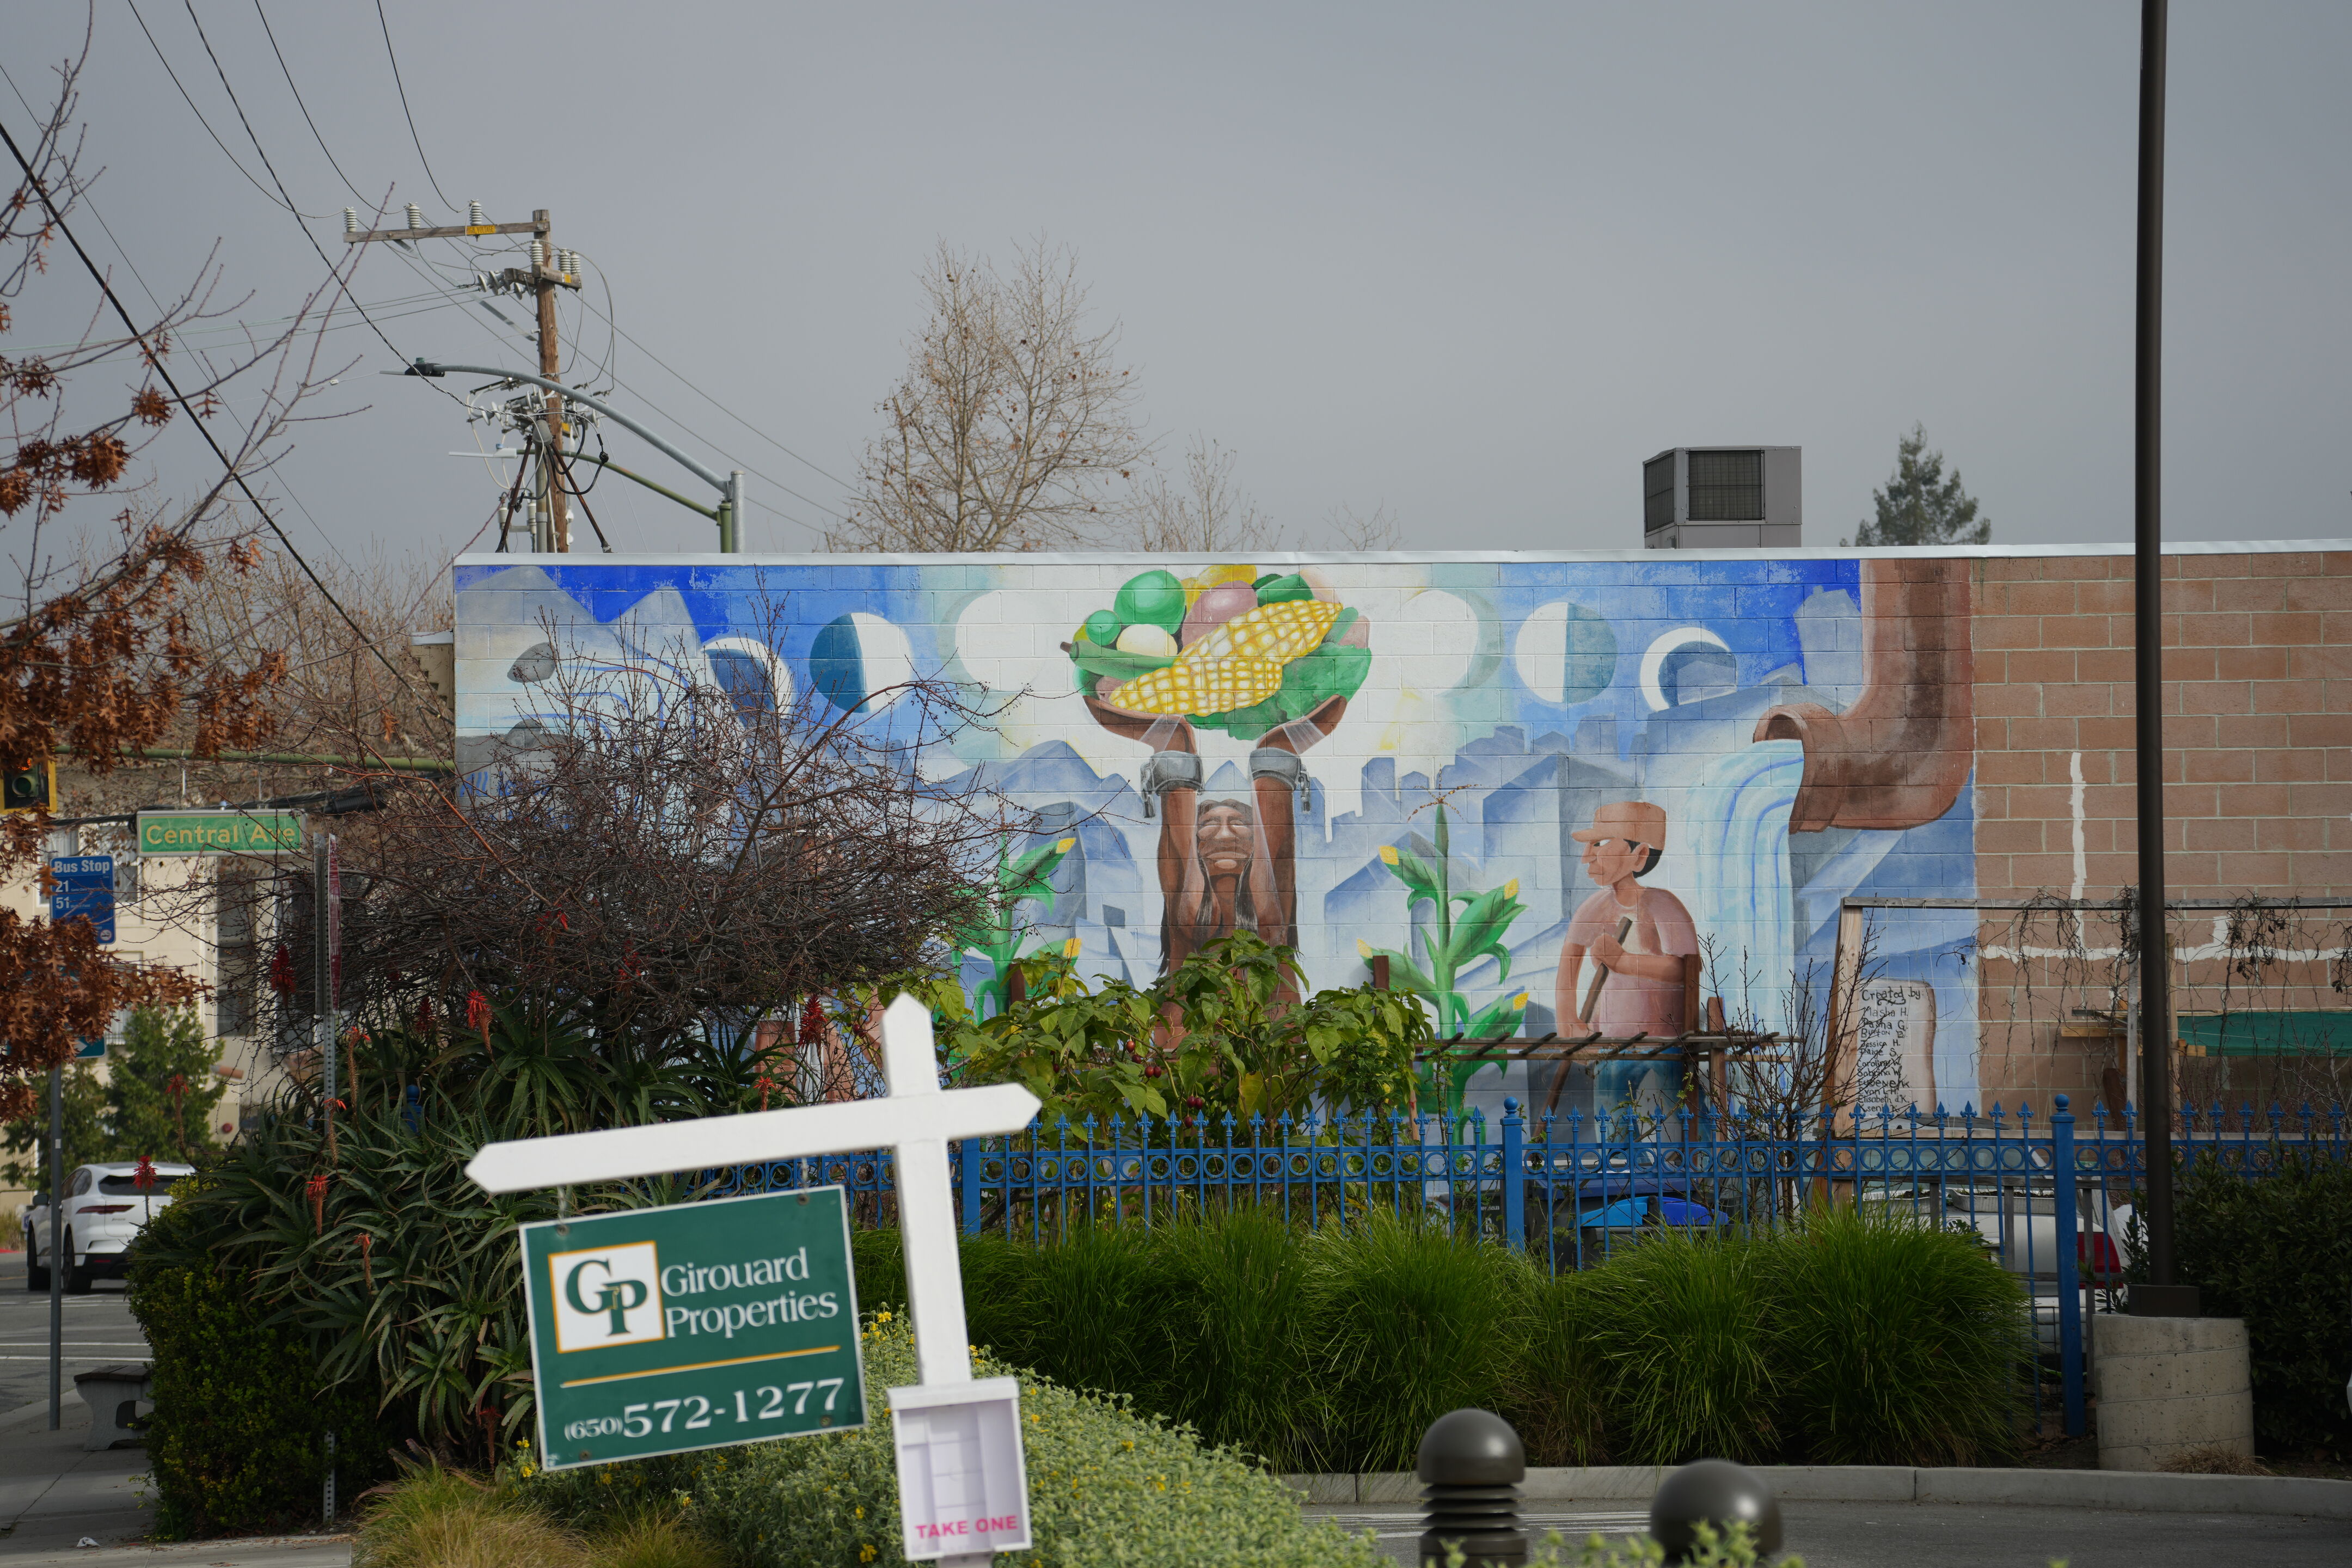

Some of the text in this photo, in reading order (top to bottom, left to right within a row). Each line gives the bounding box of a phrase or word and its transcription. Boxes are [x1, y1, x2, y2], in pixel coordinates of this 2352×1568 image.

[477, 225, 494, 234] VOLTAGE
[146, 824, 295, 844] Central Ave
[54, 860, 110, 874] Bus Stop
[56, 880, 69, 892] 21
[56, 897, 69, 909] 51
[1862, 985, 1904, 1001] Created
[1864, 1007, 1908, 1016] Masha H.
[1863, 1018, 1908, 1031] Pasha G.
[1858, 1095, 1892, 1104] Elisabeth
[660, 1246, 810, 1296] Girouard
[565, 1258, 648, 1337] GP
[665, 1290, 839, 1338] Properties
[915, 1515, 1018, 1539] TAKE ONE
